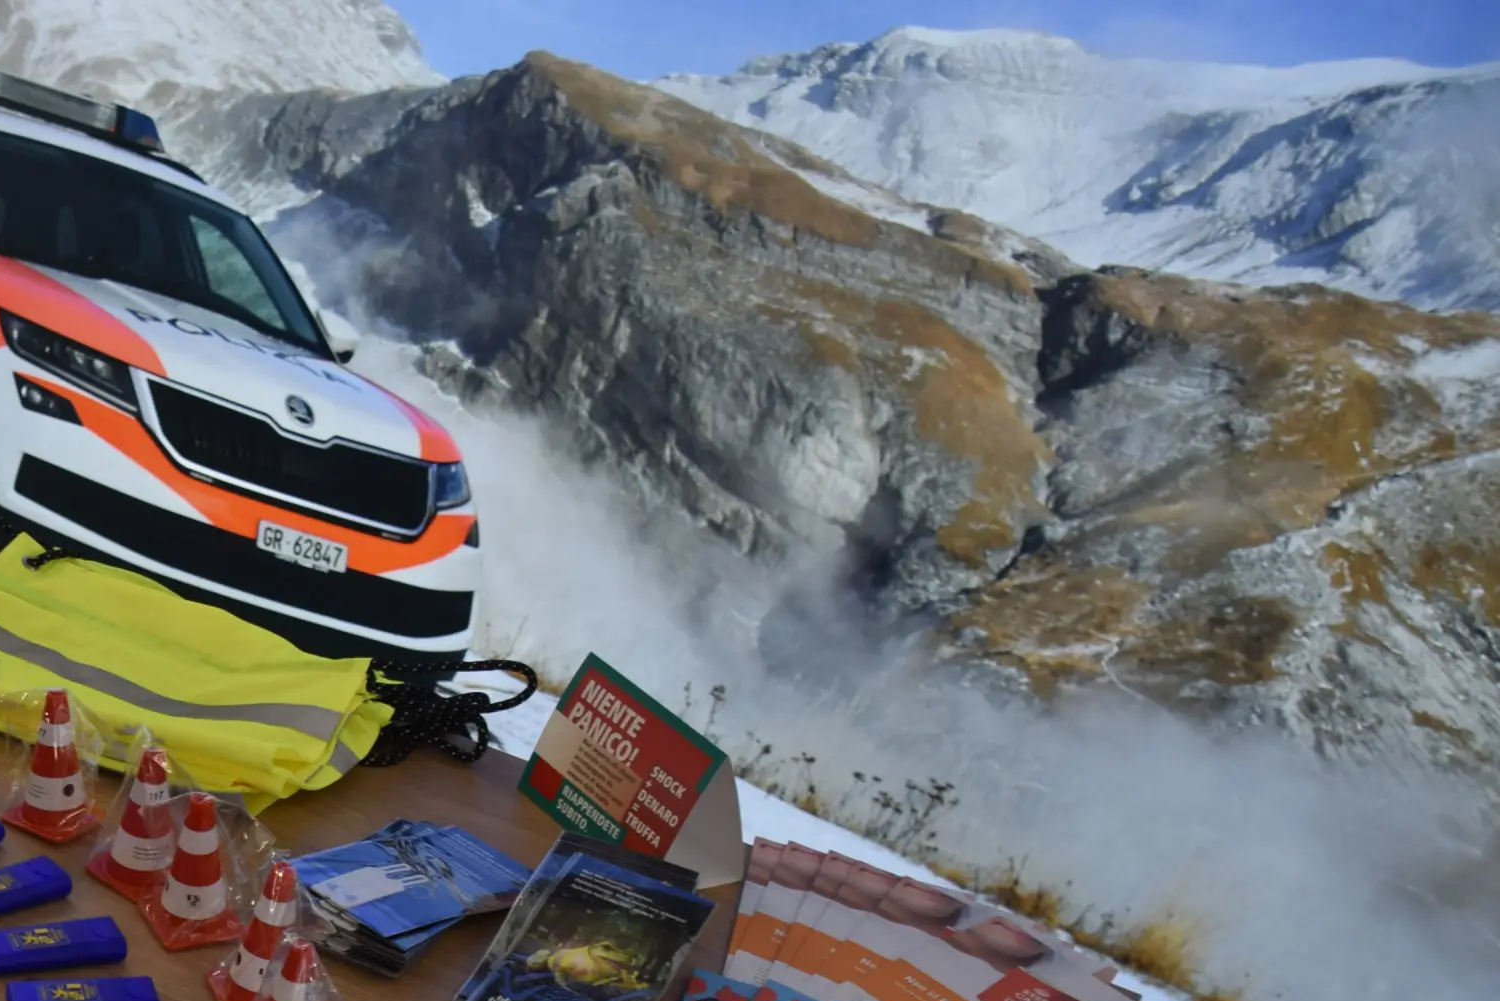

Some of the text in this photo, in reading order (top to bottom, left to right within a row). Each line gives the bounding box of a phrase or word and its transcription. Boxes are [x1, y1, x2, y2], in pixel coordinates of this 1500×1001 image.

[124, 307, 363, 393] POLIZIA
[293, 536, 343, 568] 62847
[580, 680, 646, 738] NIENTE
[567, 702, 640, 769] PANICO!
[650, 765, 687, 799] SHOCK
[555, 798, 588, 833] SUBITO.
[561, 785, 622, 840] RIAPPENDETE
[637, 788, 679, 828] DENARO
[624, 812, 661, 849] TRUFFA
[904, 976, 928, 992] Non
